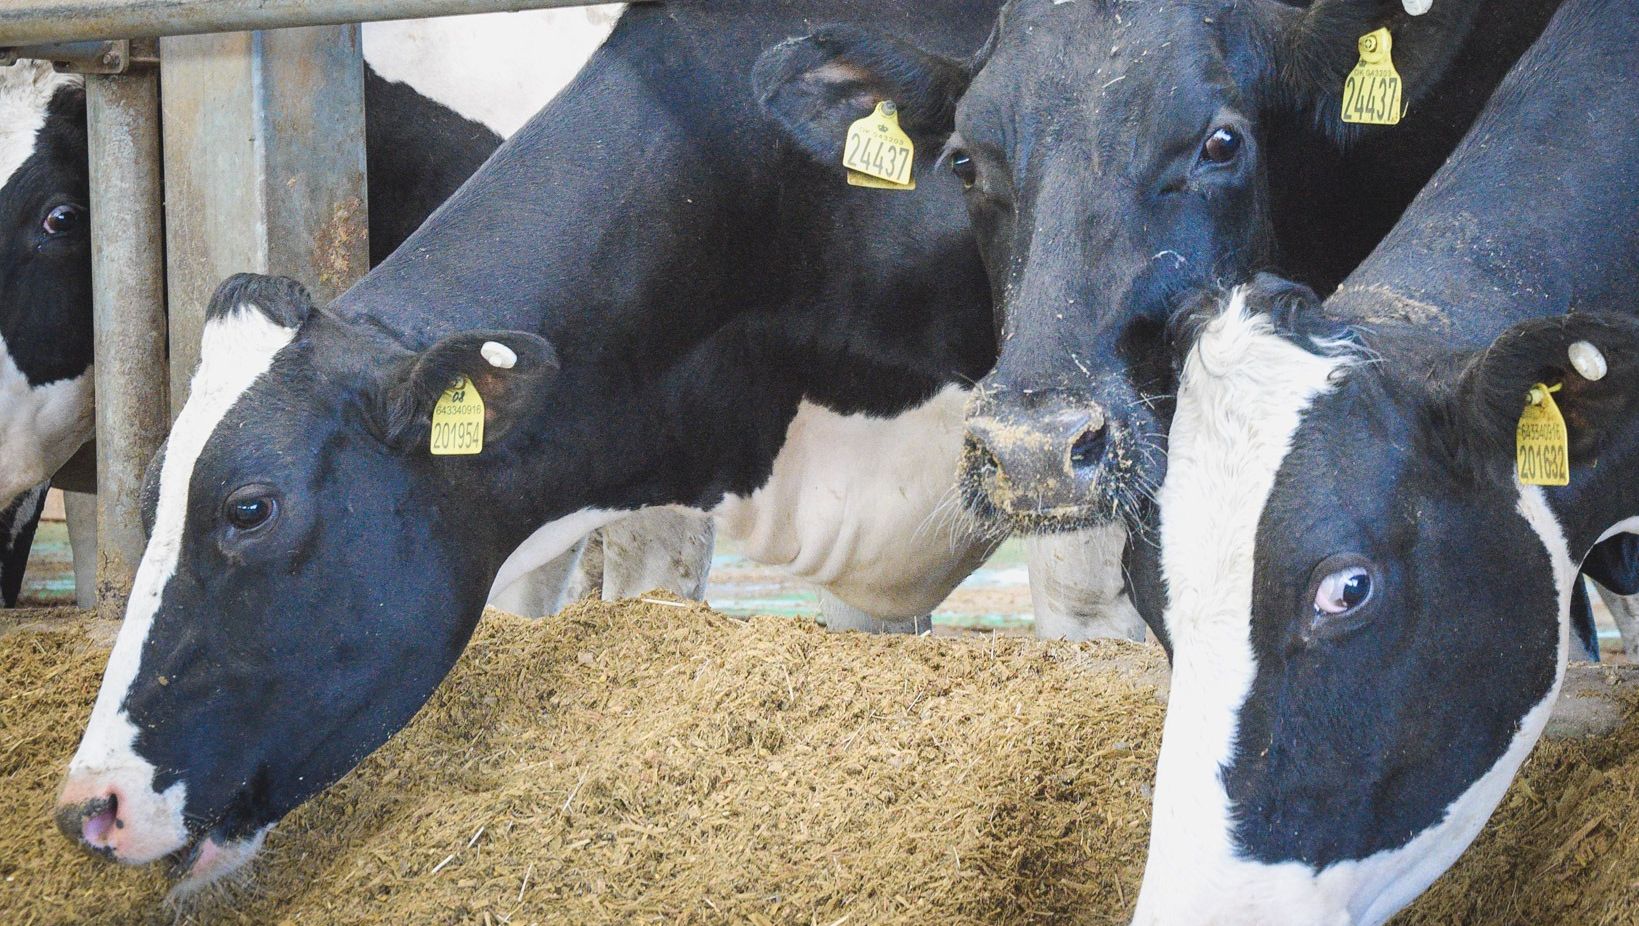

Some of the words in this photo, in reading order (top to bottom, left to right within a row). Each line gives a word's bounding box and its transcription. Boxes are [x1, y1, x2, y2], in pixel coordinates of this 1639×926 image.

[1343, 76, 1398, 120] 24437
[847, 133, 910, 180] 24437
[433, 422, 480, 449] 201954
[1519, 445, 1567, 480] 201632
